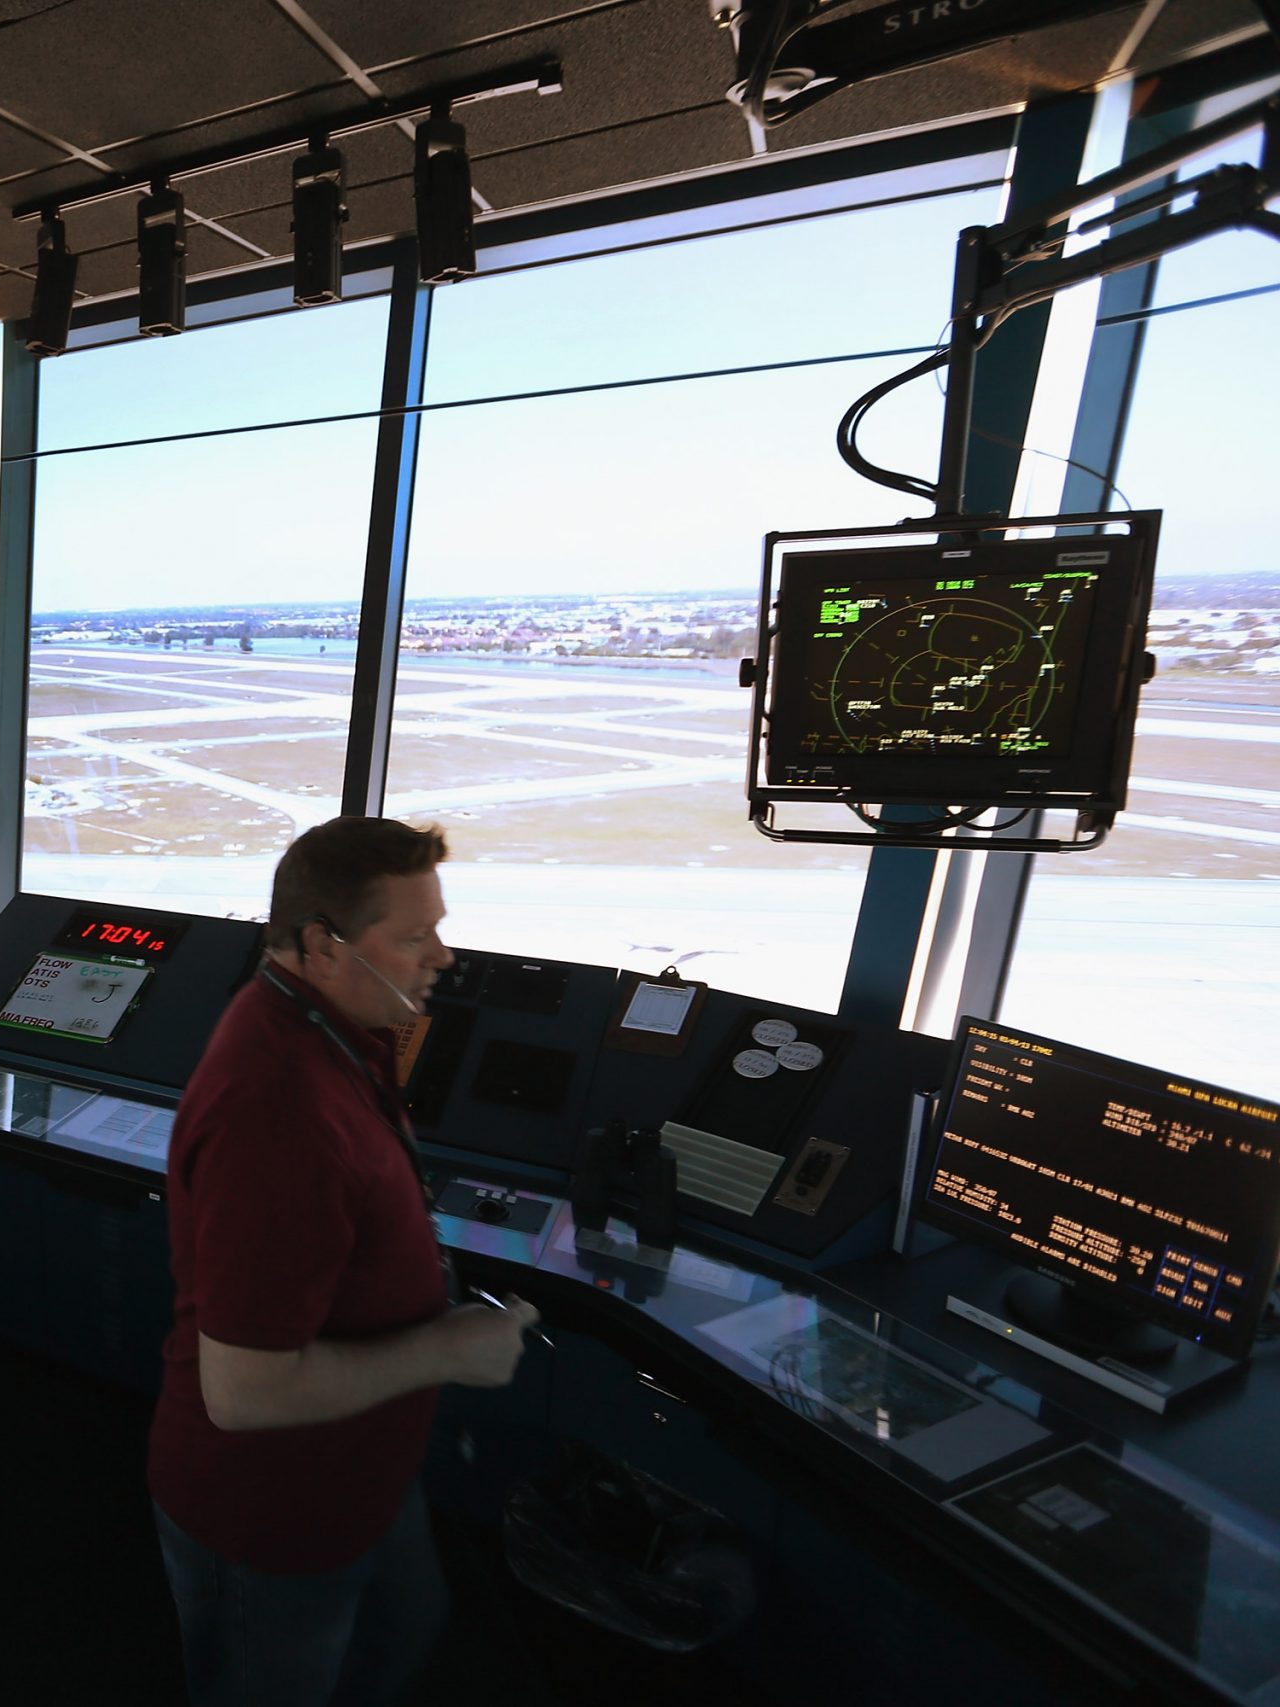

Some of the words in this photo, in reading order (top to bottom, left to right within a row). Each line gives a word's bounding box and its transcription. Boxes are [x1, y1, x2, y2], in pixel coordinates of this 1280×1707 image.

[38, 958, 73, 970] FLOW
[30, 968, 61, 979] ATIS
[24, 977, 50, 988] OTS
[91, 983, 124, 1003] J
[0, 1011, 21, 1024] MIA
[21, 1016, 55, 1029] FREQ
[970, 1059, 1008, 1076] VISIBILITY
[1167, 1083, 1192, 1097] MIAMI
[1212, 1096, 1238, 1111] LOCKA
[1240, 1104, 1278, 1122] AIRPORT
[1104, 1110, 1123, 1121] WIND
[1102, 1118, 1142, 1137] ALTIMETER
[936, 1176, 965, 1192] RELATIVE
[1051, 1222, 1084, 1241] PRESSURE
[1052, 1215, 1083, 1232] STATION
[1048, 1230, 1079, 1248] DENSITY
[1010, 1233, 1039, 1249] AUDIBLE
[1040, 1245, 1066, 1260] ALARMS
[1066, 1256, 1081, 1267] ARE
[1082, 1262, 1118, 1282] DISABLED
[1166, 1250, 1191, 1267] PRINT
[1037, 1265, 1076, 1286] SAMSUNG
[1182, 1294, 1204, 1309] EDIT
